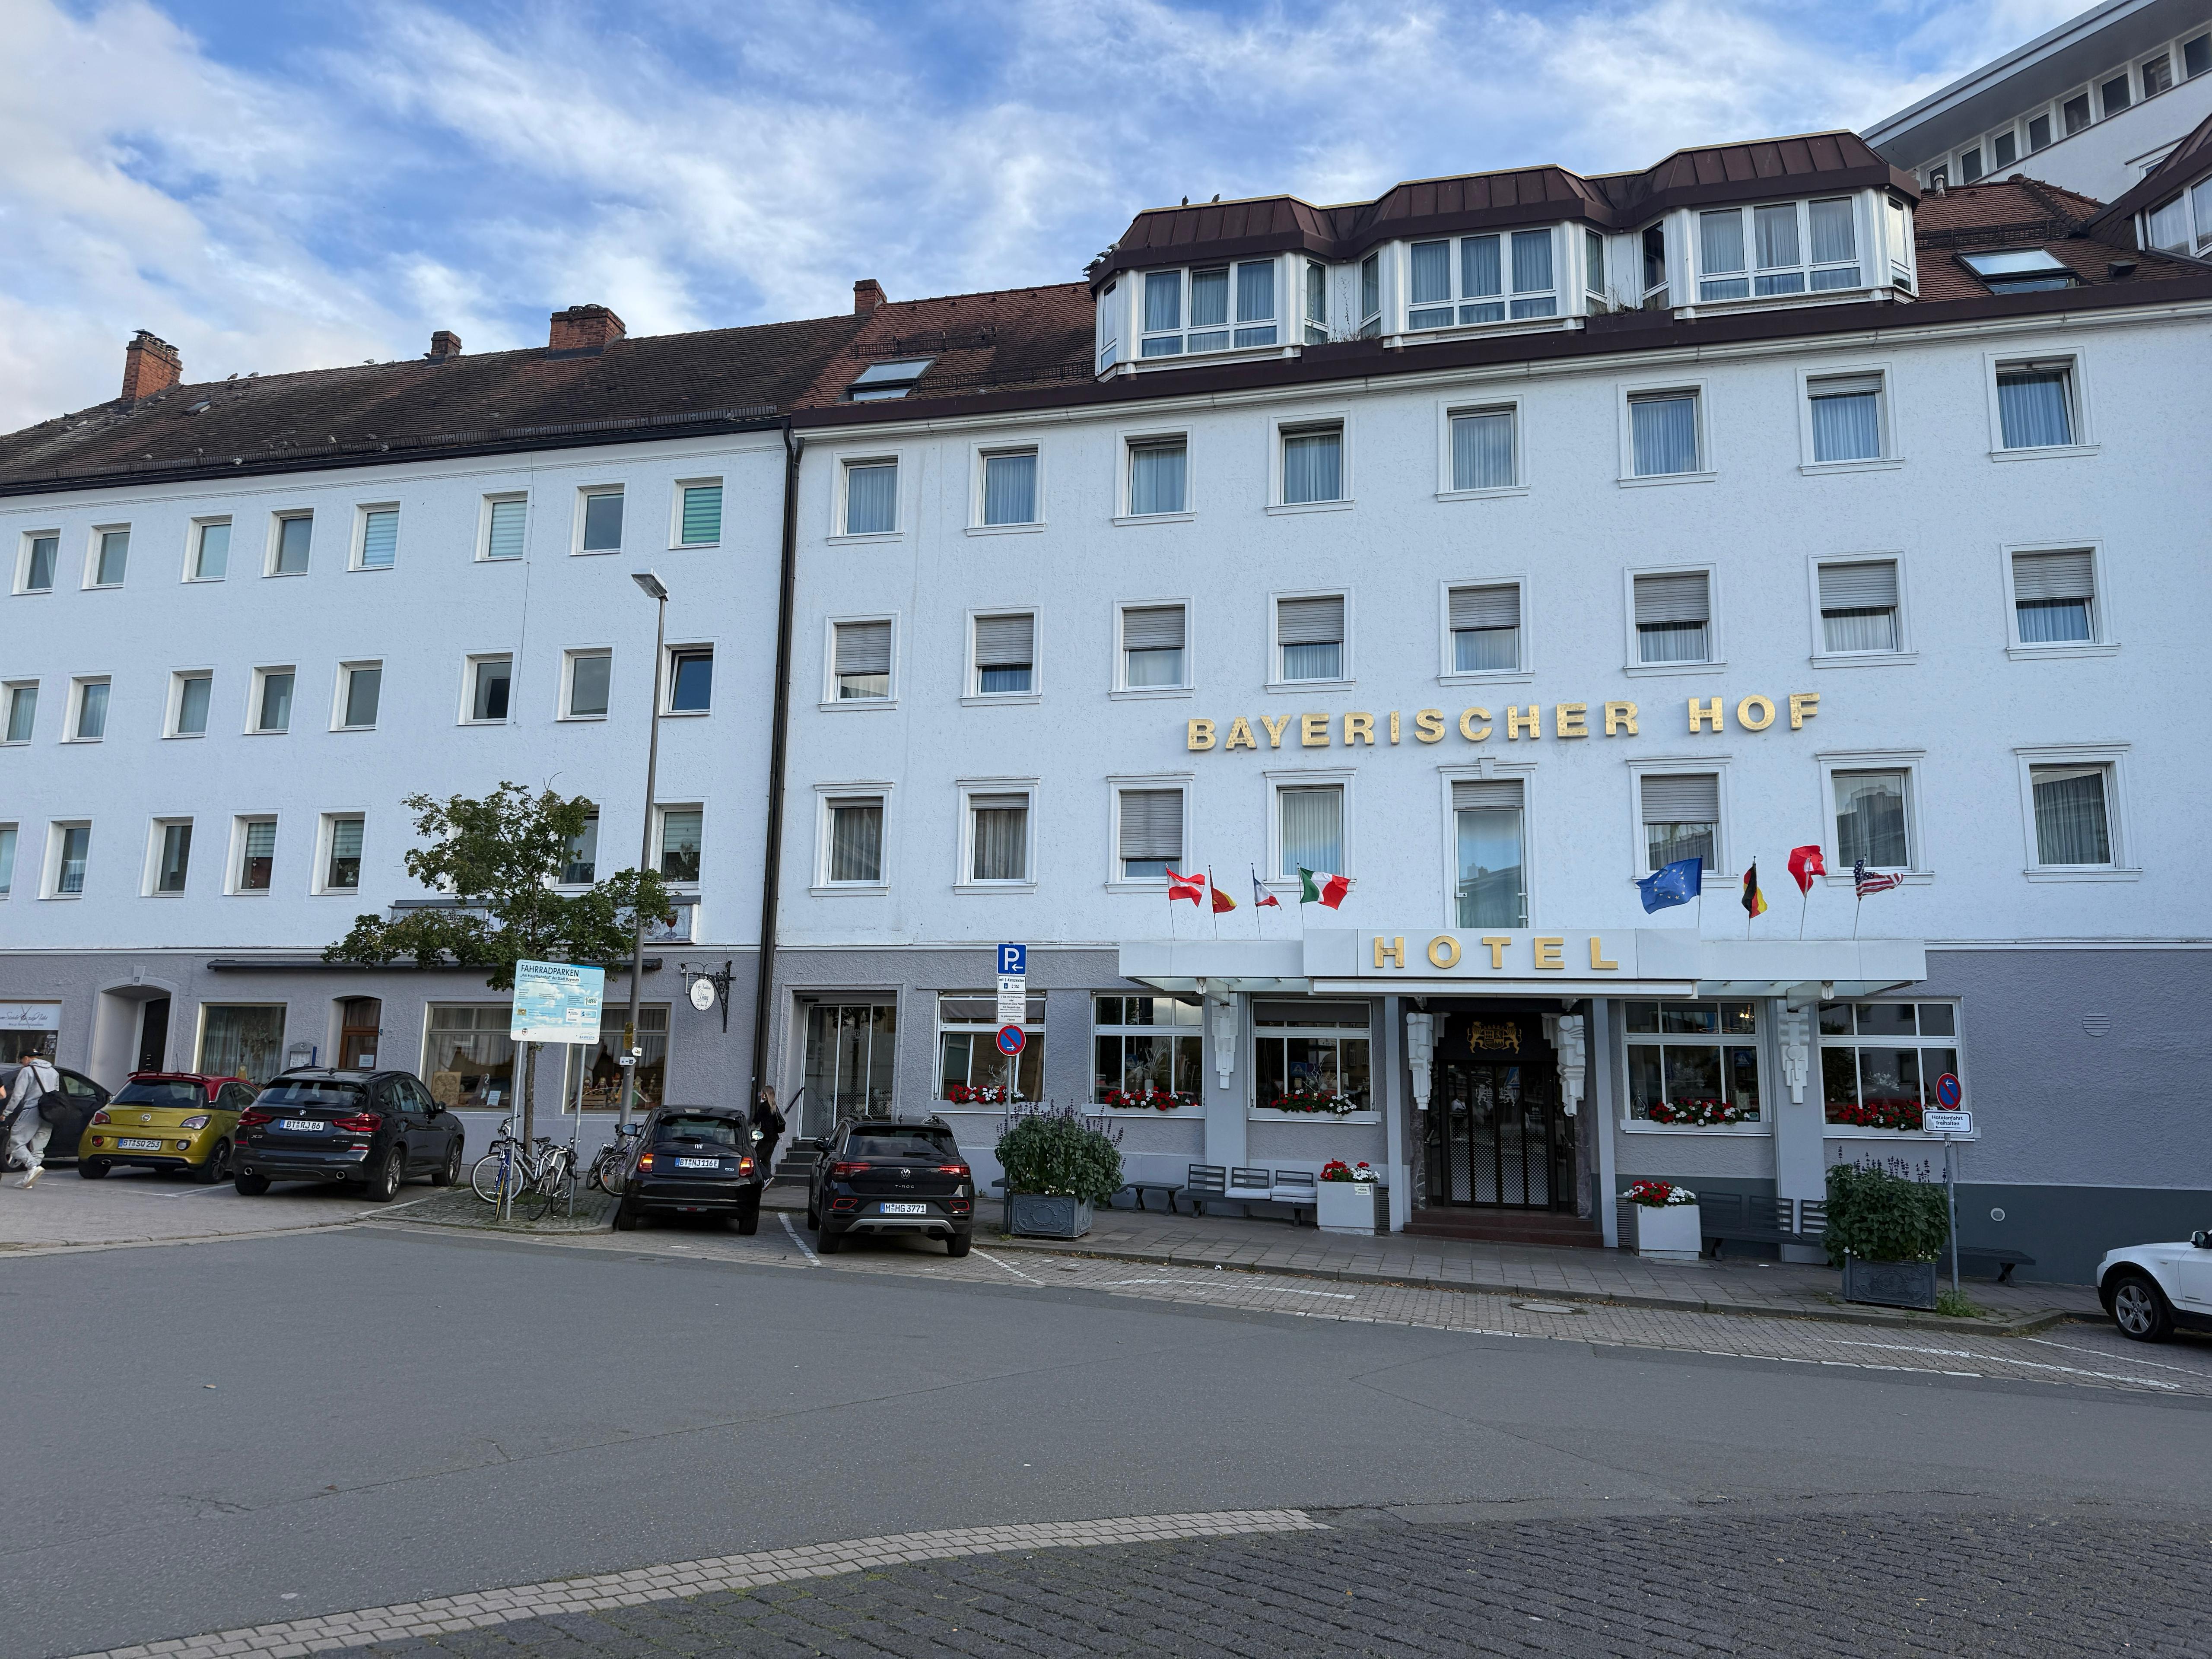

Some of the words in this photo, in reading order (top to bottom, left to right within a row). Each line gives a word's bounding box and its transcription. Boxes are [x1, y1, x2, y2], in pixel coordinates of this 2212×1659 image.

[1188, 700, 1639, 751] BAYERISCHER
[1688, 693, 1820, 733] HOF
[1004, 948, 1020, 970] P
[1374, 935, 1618, 969] HOTEL
[521, 964, 579, 977] FAHRRADPARKEN
